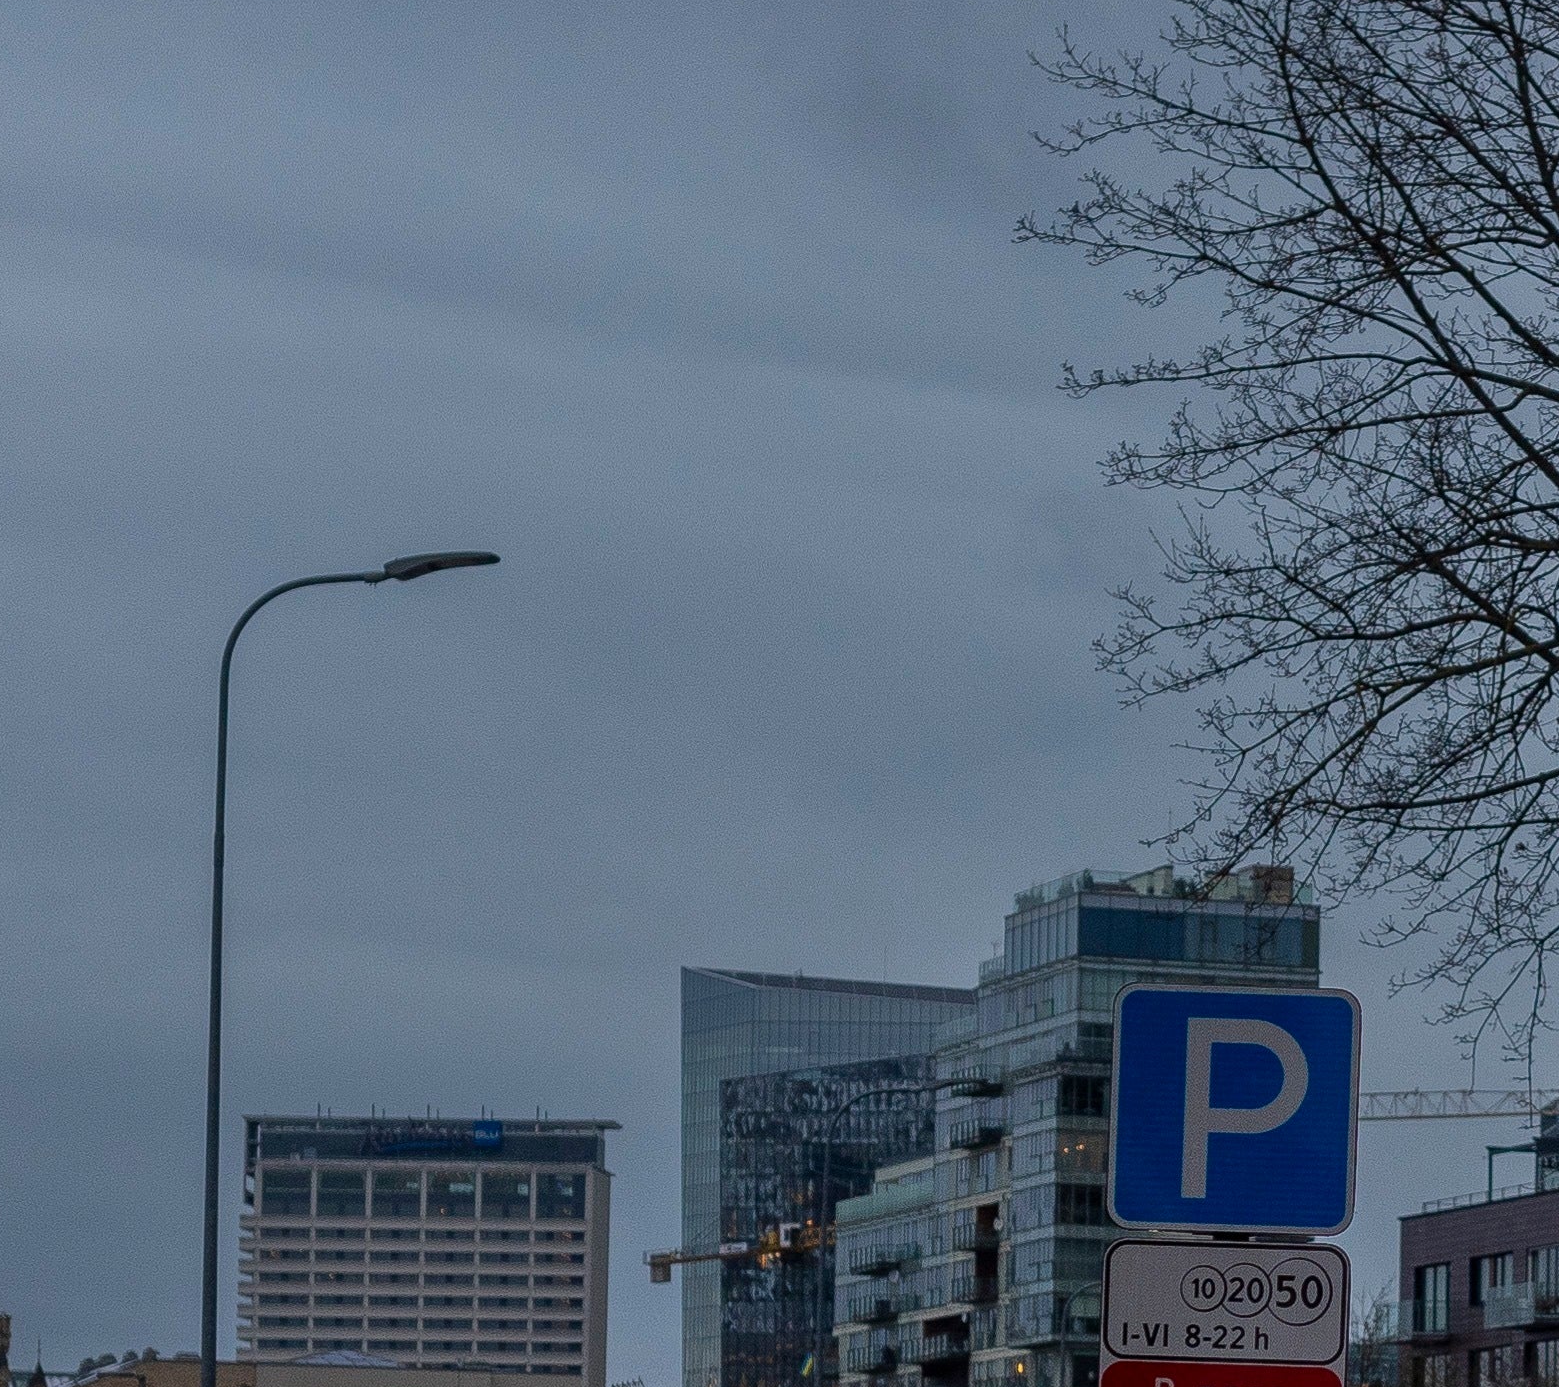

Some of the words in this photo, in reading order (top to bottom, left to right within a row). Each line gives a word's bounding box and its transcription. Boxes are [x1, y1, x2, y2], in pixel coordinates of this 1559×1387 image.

[1181, 1017, 1309, 1199] P
[1192, 1279, 1214, 1299] 10
[1228, 1278, 1265, 1303] 20
[1275, 1276, 1324, 1309] 50
[1121, 1322, 1169, 1348] I-VI
[1185, 1325, 1245, 1350] 8-22
[1254, 1328, 1269, 1351] h
